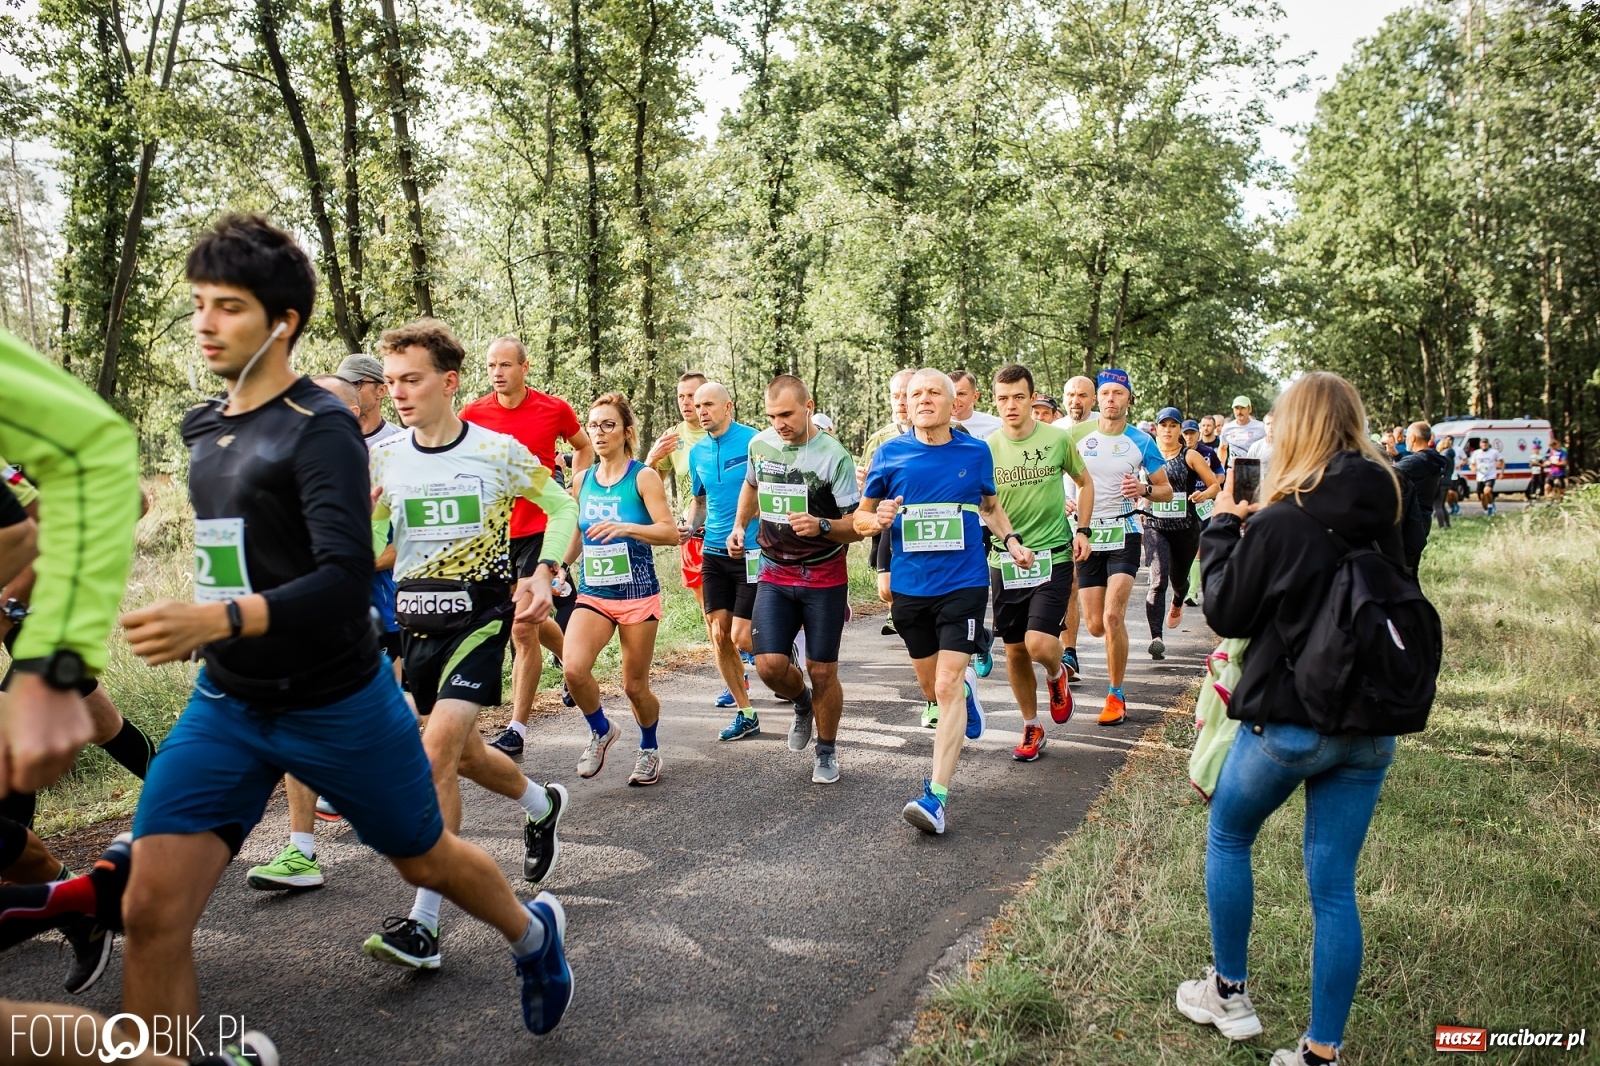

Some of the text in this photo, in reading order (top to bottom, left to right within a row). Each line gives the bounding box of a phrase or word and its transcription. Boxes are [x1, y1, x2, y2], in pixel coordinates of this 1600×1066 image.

[422, 499, 460, 525] 30
[585, 502, 622, 521] bbl
[772, 496, 790, 513] 91
[915, 520, 950, 540] 137
[1094, 529, 1113, 543] 27
[592, 558, 616, 576] 92
[399, 595, 466, 613] adidas
